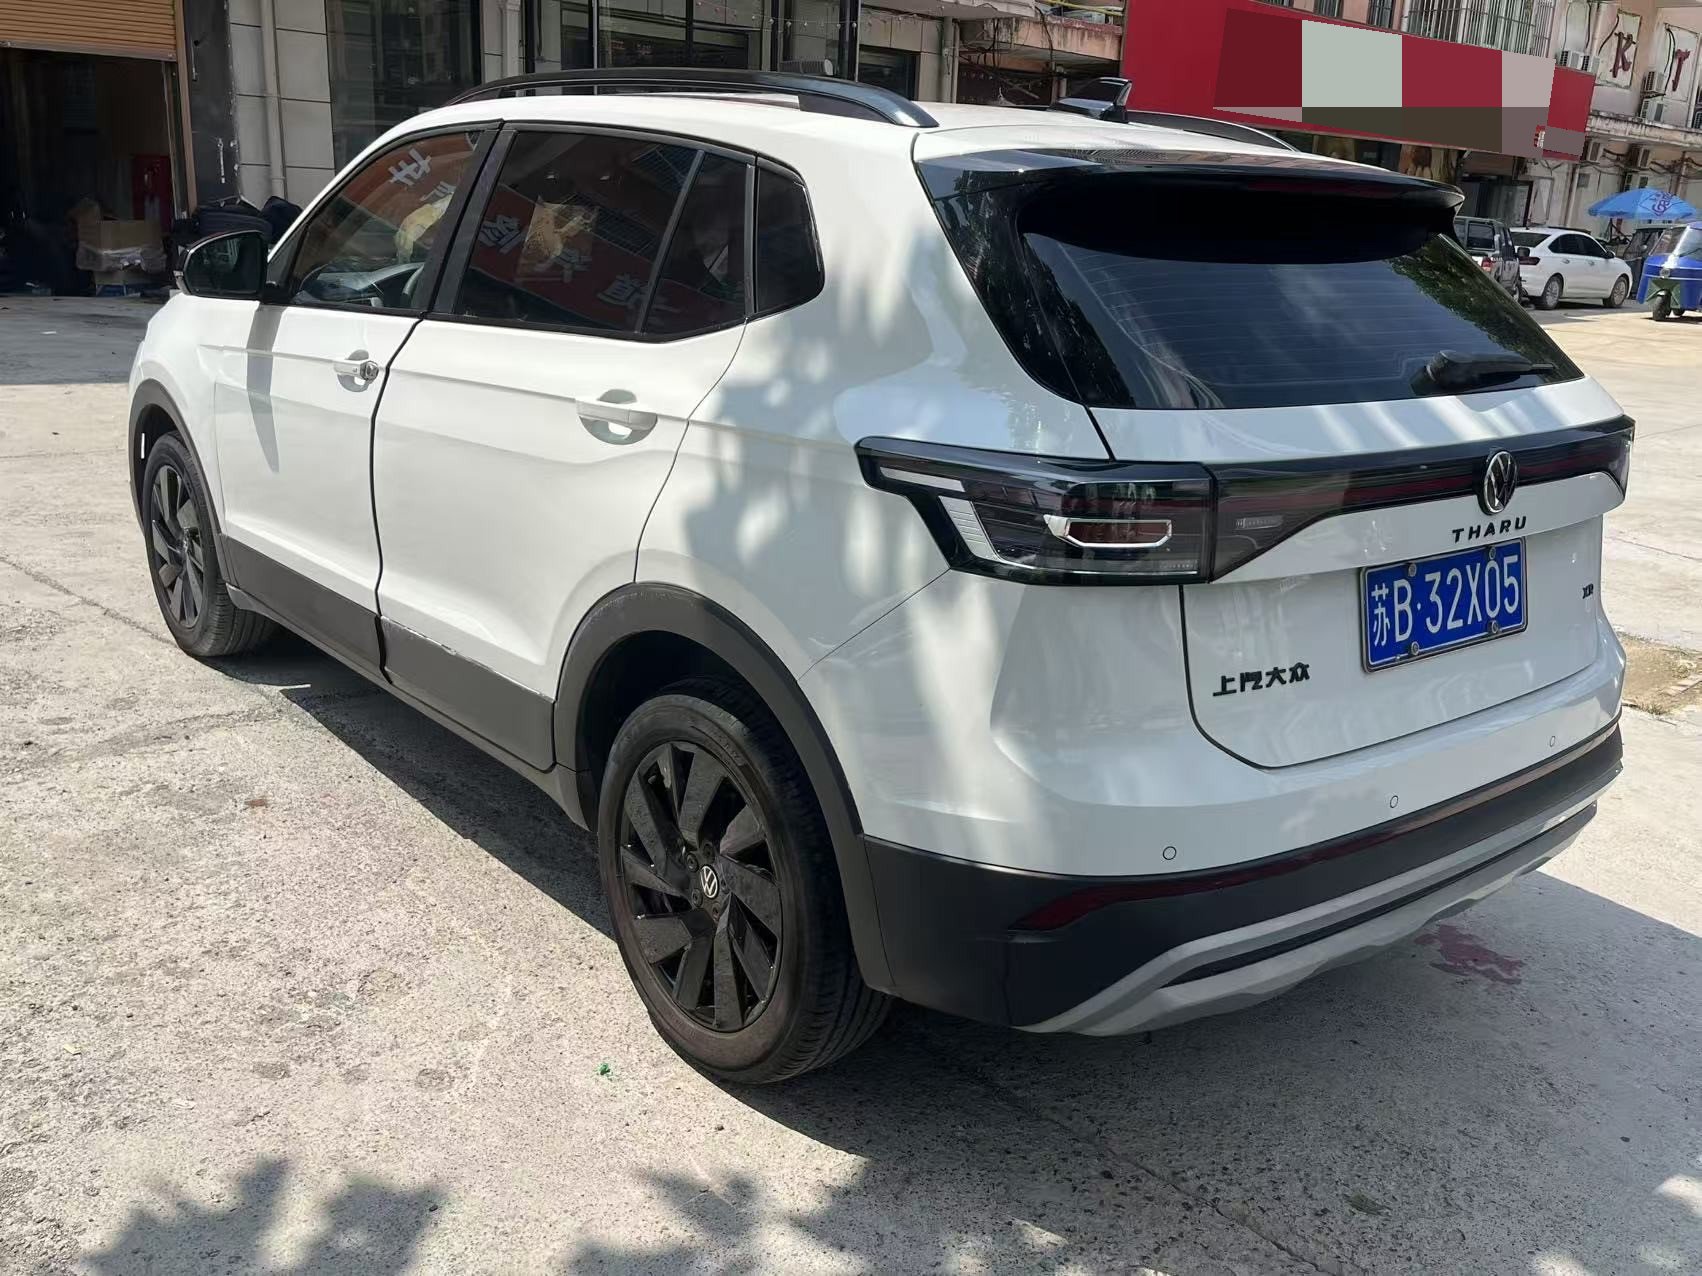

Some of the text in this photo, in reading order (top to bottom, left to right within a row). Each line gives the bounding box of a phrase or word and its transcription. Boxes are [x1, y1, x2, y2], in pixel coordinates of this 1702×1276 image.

[1452, 516, 1527, 543] THARU
[1371, 555, 1519, 647] 苏B·32X05
[1212, 662, 1310, 697] 上汽大众
